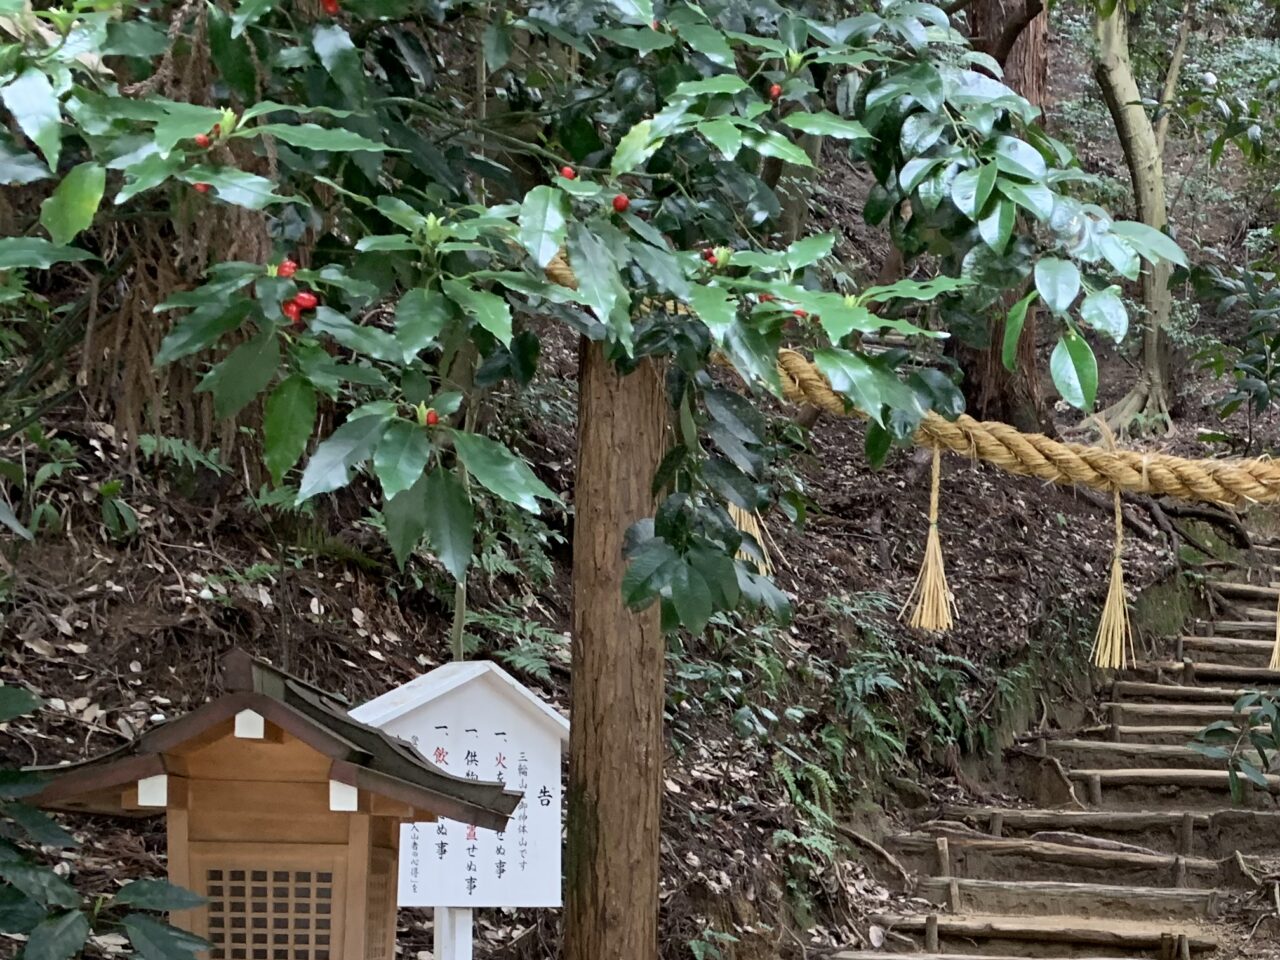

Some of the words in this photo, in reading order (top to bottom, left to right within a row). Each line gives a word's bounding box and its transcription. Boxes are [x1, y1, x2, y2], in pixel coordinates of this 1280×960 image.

[517, 751, 529, 871] 三輪山御神体山です
[537, 785, 554, 807] 告
